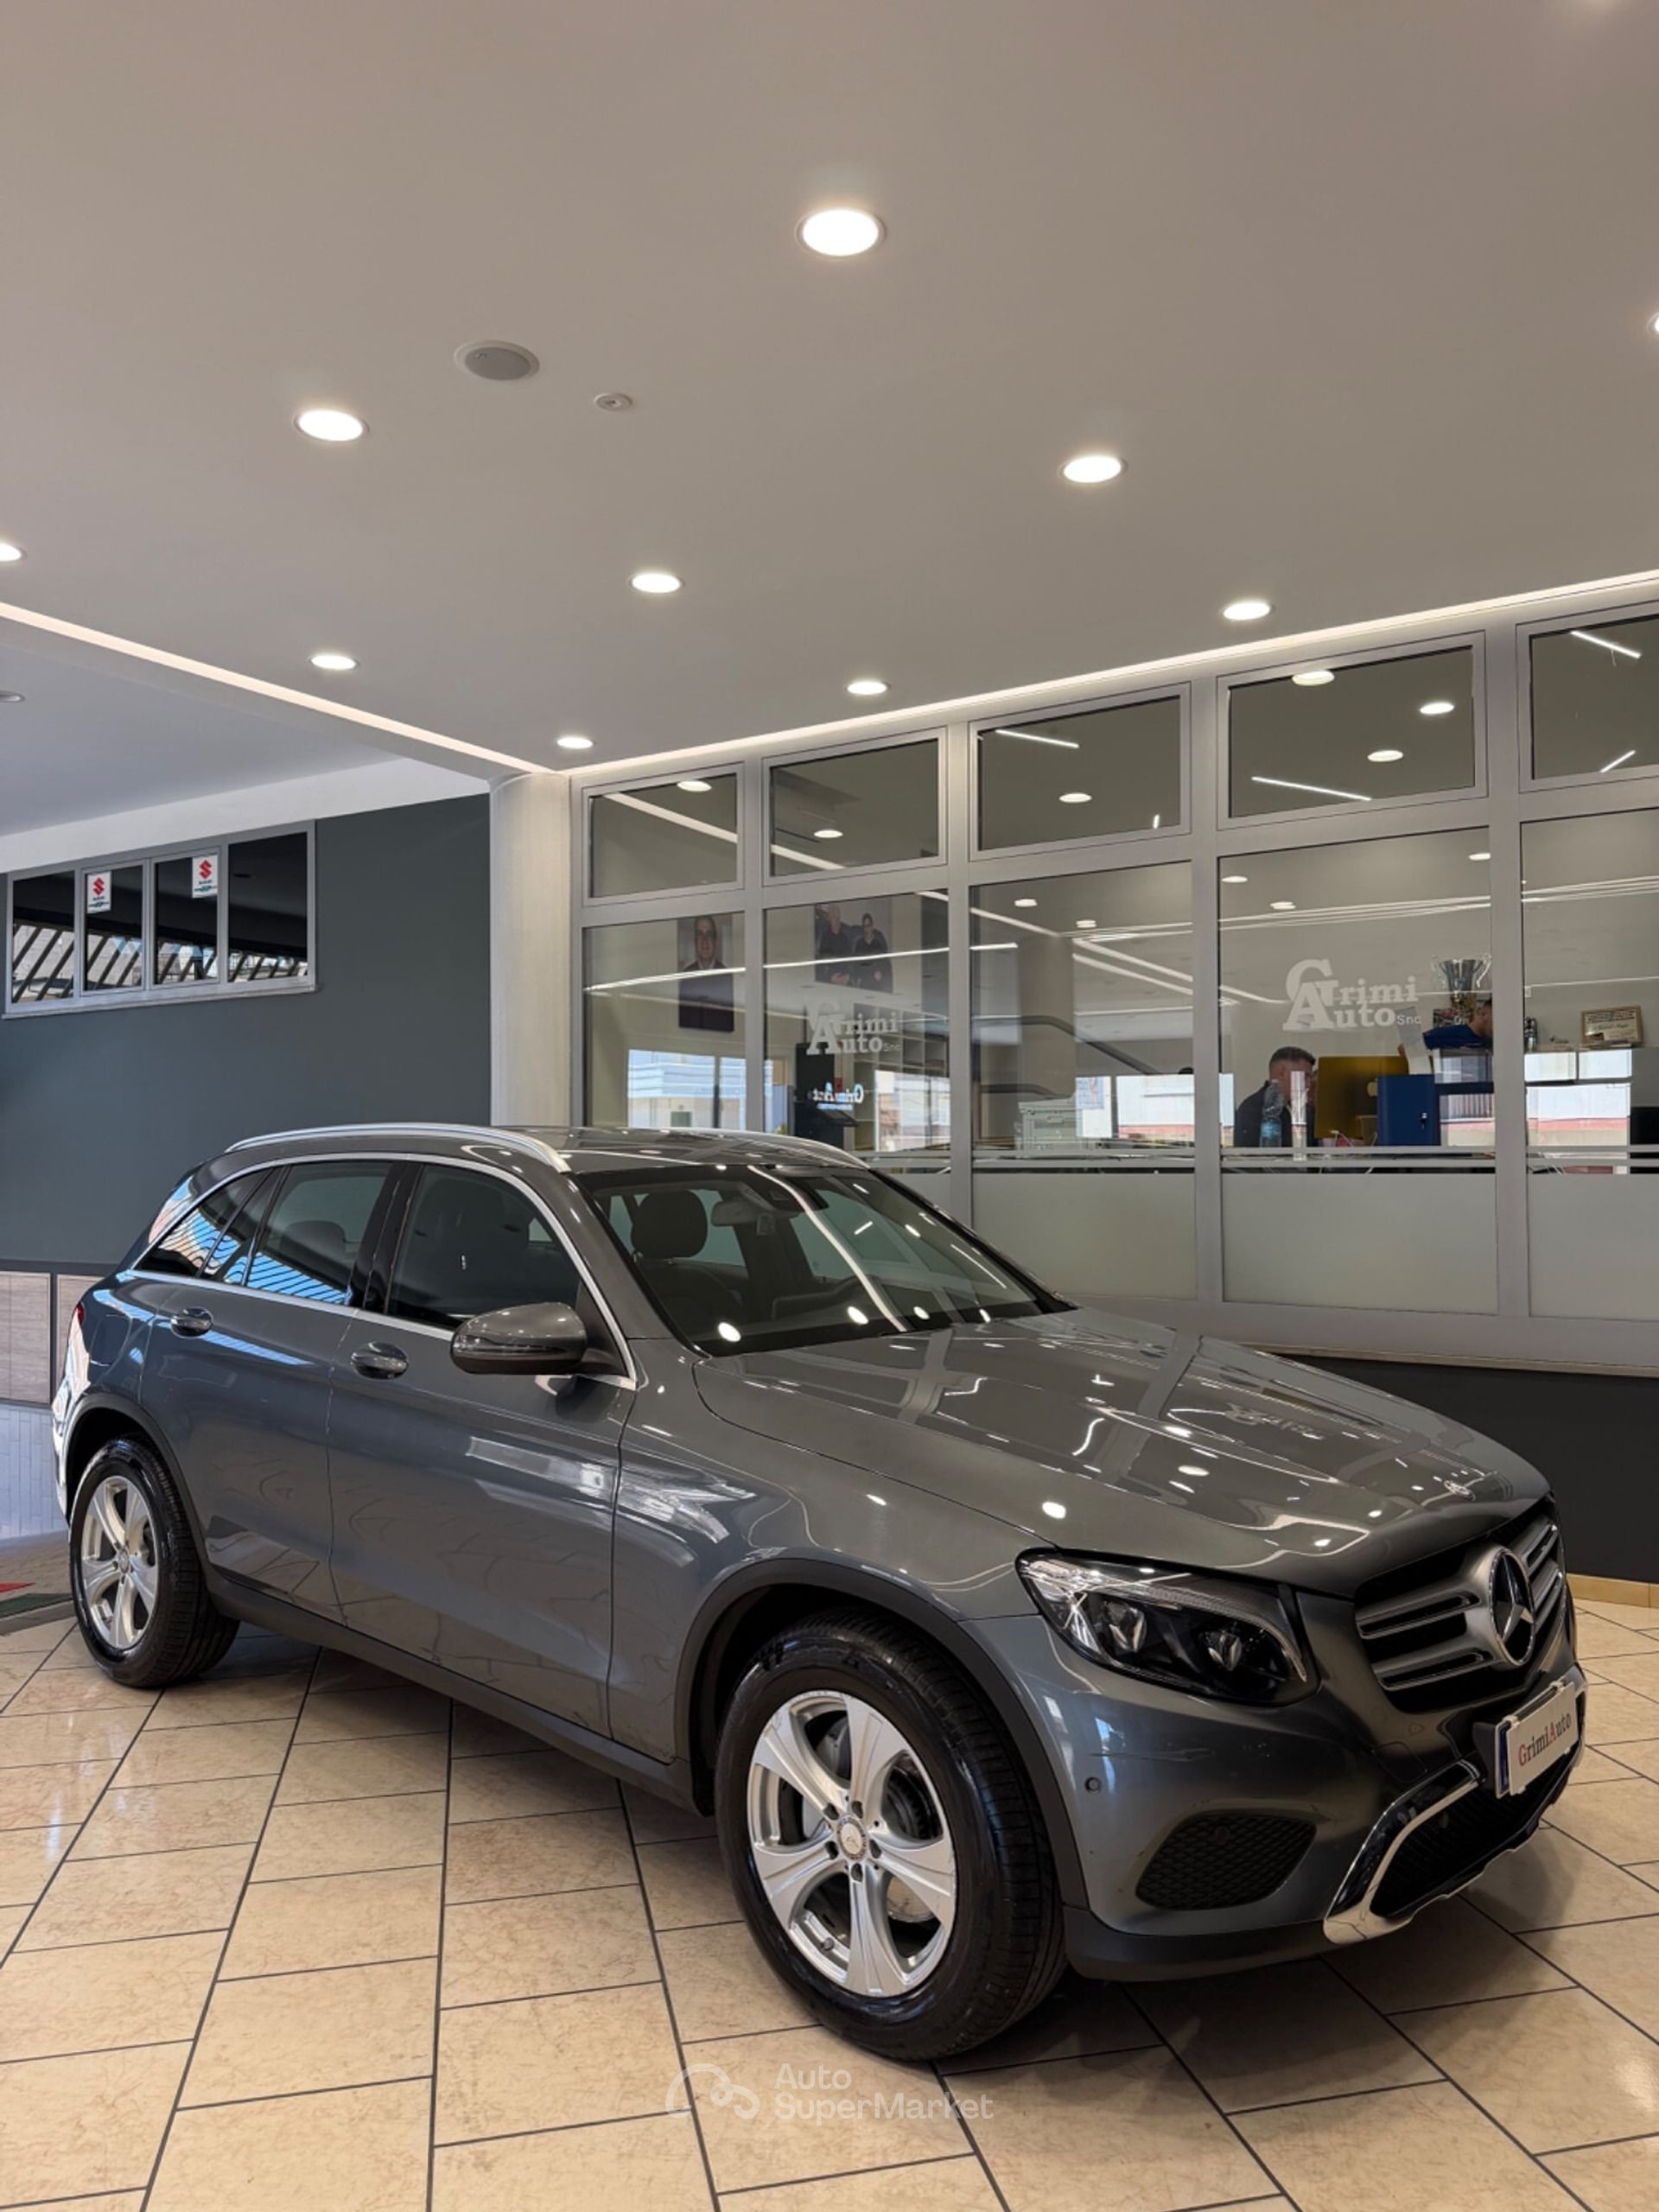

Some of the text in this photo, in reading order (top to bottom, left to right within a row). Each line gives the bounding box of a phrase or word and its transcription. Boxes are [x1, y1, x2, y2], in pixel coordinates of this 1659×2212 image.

[1282, 982, 1395, 1031] Auto
[1286, 959, 1419, 1006] Grimi
[806, 1015, 882, 1055] Auto
[1518, 1713, 1572, 1766] GrimiAuto
